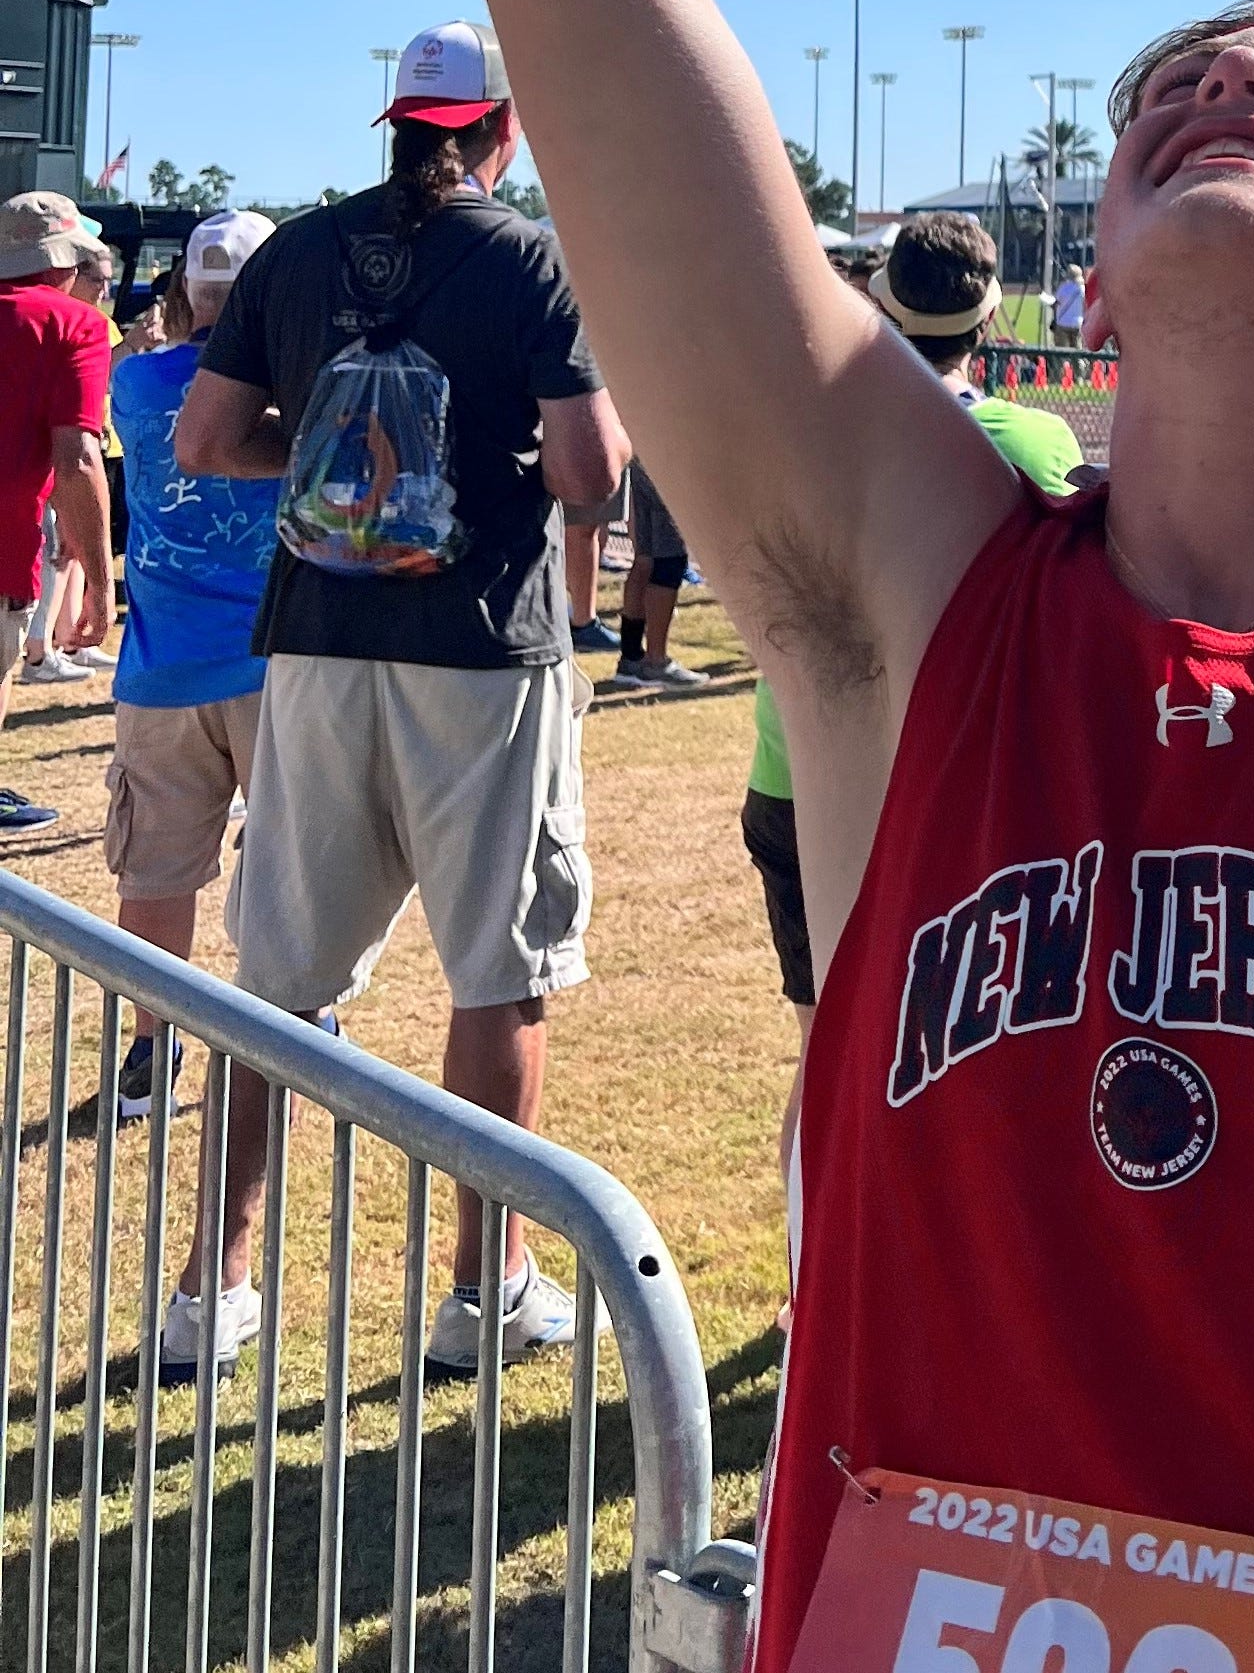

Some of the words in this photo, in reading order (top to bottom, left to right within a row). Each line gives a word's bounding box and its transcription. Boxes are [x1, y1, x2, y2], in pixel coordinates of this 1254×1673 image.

[887, 840, 1104, 1107] NEW
[1100, 1055, 1128, 1090] 2022
[1129, 1049, 1157, 1064] USA
[1160, 1058, 1203, 1103] GAMES
[1098, 1122, 1121, 1166] TEAM
[1121, 1160, 1156, 1178] NEW
[1161, 1132, 1204, 1176] JERSEY
[908, 1487, 1019, 1544] 2022
[1024, 1510, 1111, 1566] USA
